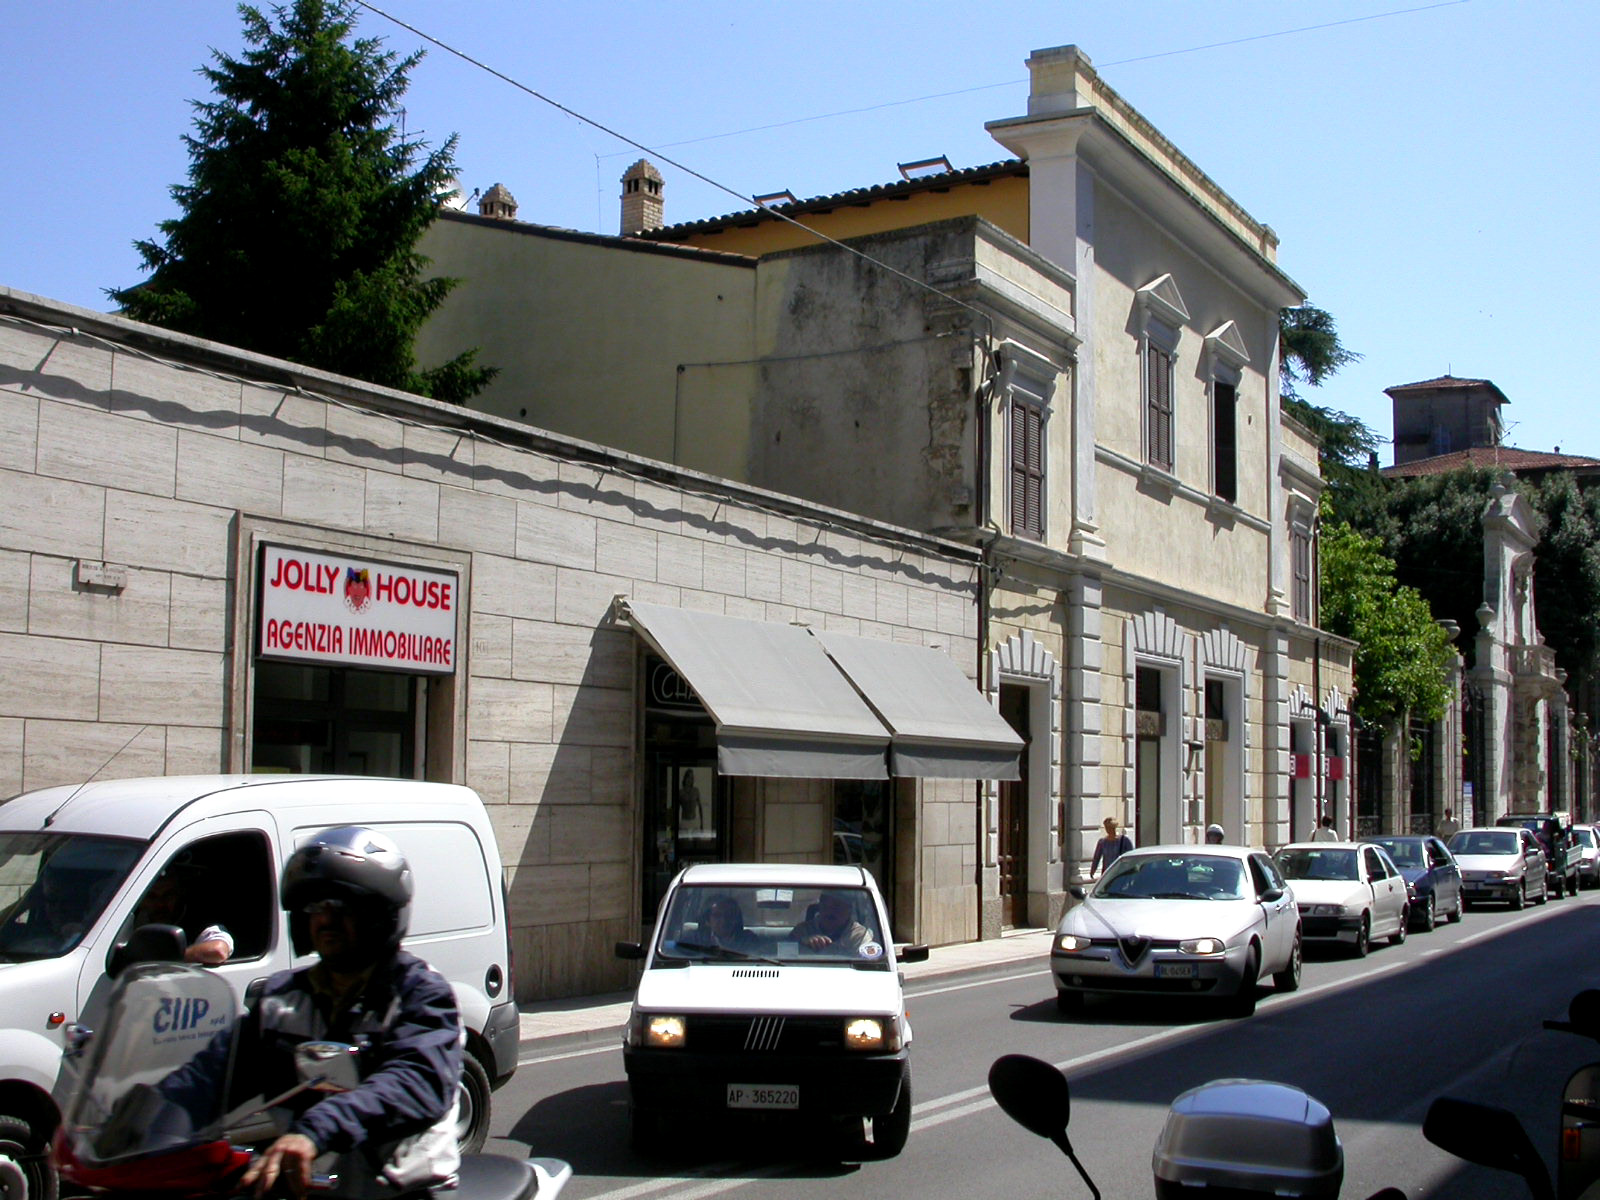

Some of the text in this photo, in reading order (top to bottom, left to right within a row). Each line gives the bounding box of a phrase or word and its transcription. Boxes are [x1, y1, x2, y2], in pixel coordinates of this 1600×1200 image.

[271, 558, 451, 611] JOLLY HOUSE
[267, 618, 343, 654] AGENZIA
[349, 627, 451, 665] IMMOBILIARE
[729, 1090, 798, 1104] AP 365220
